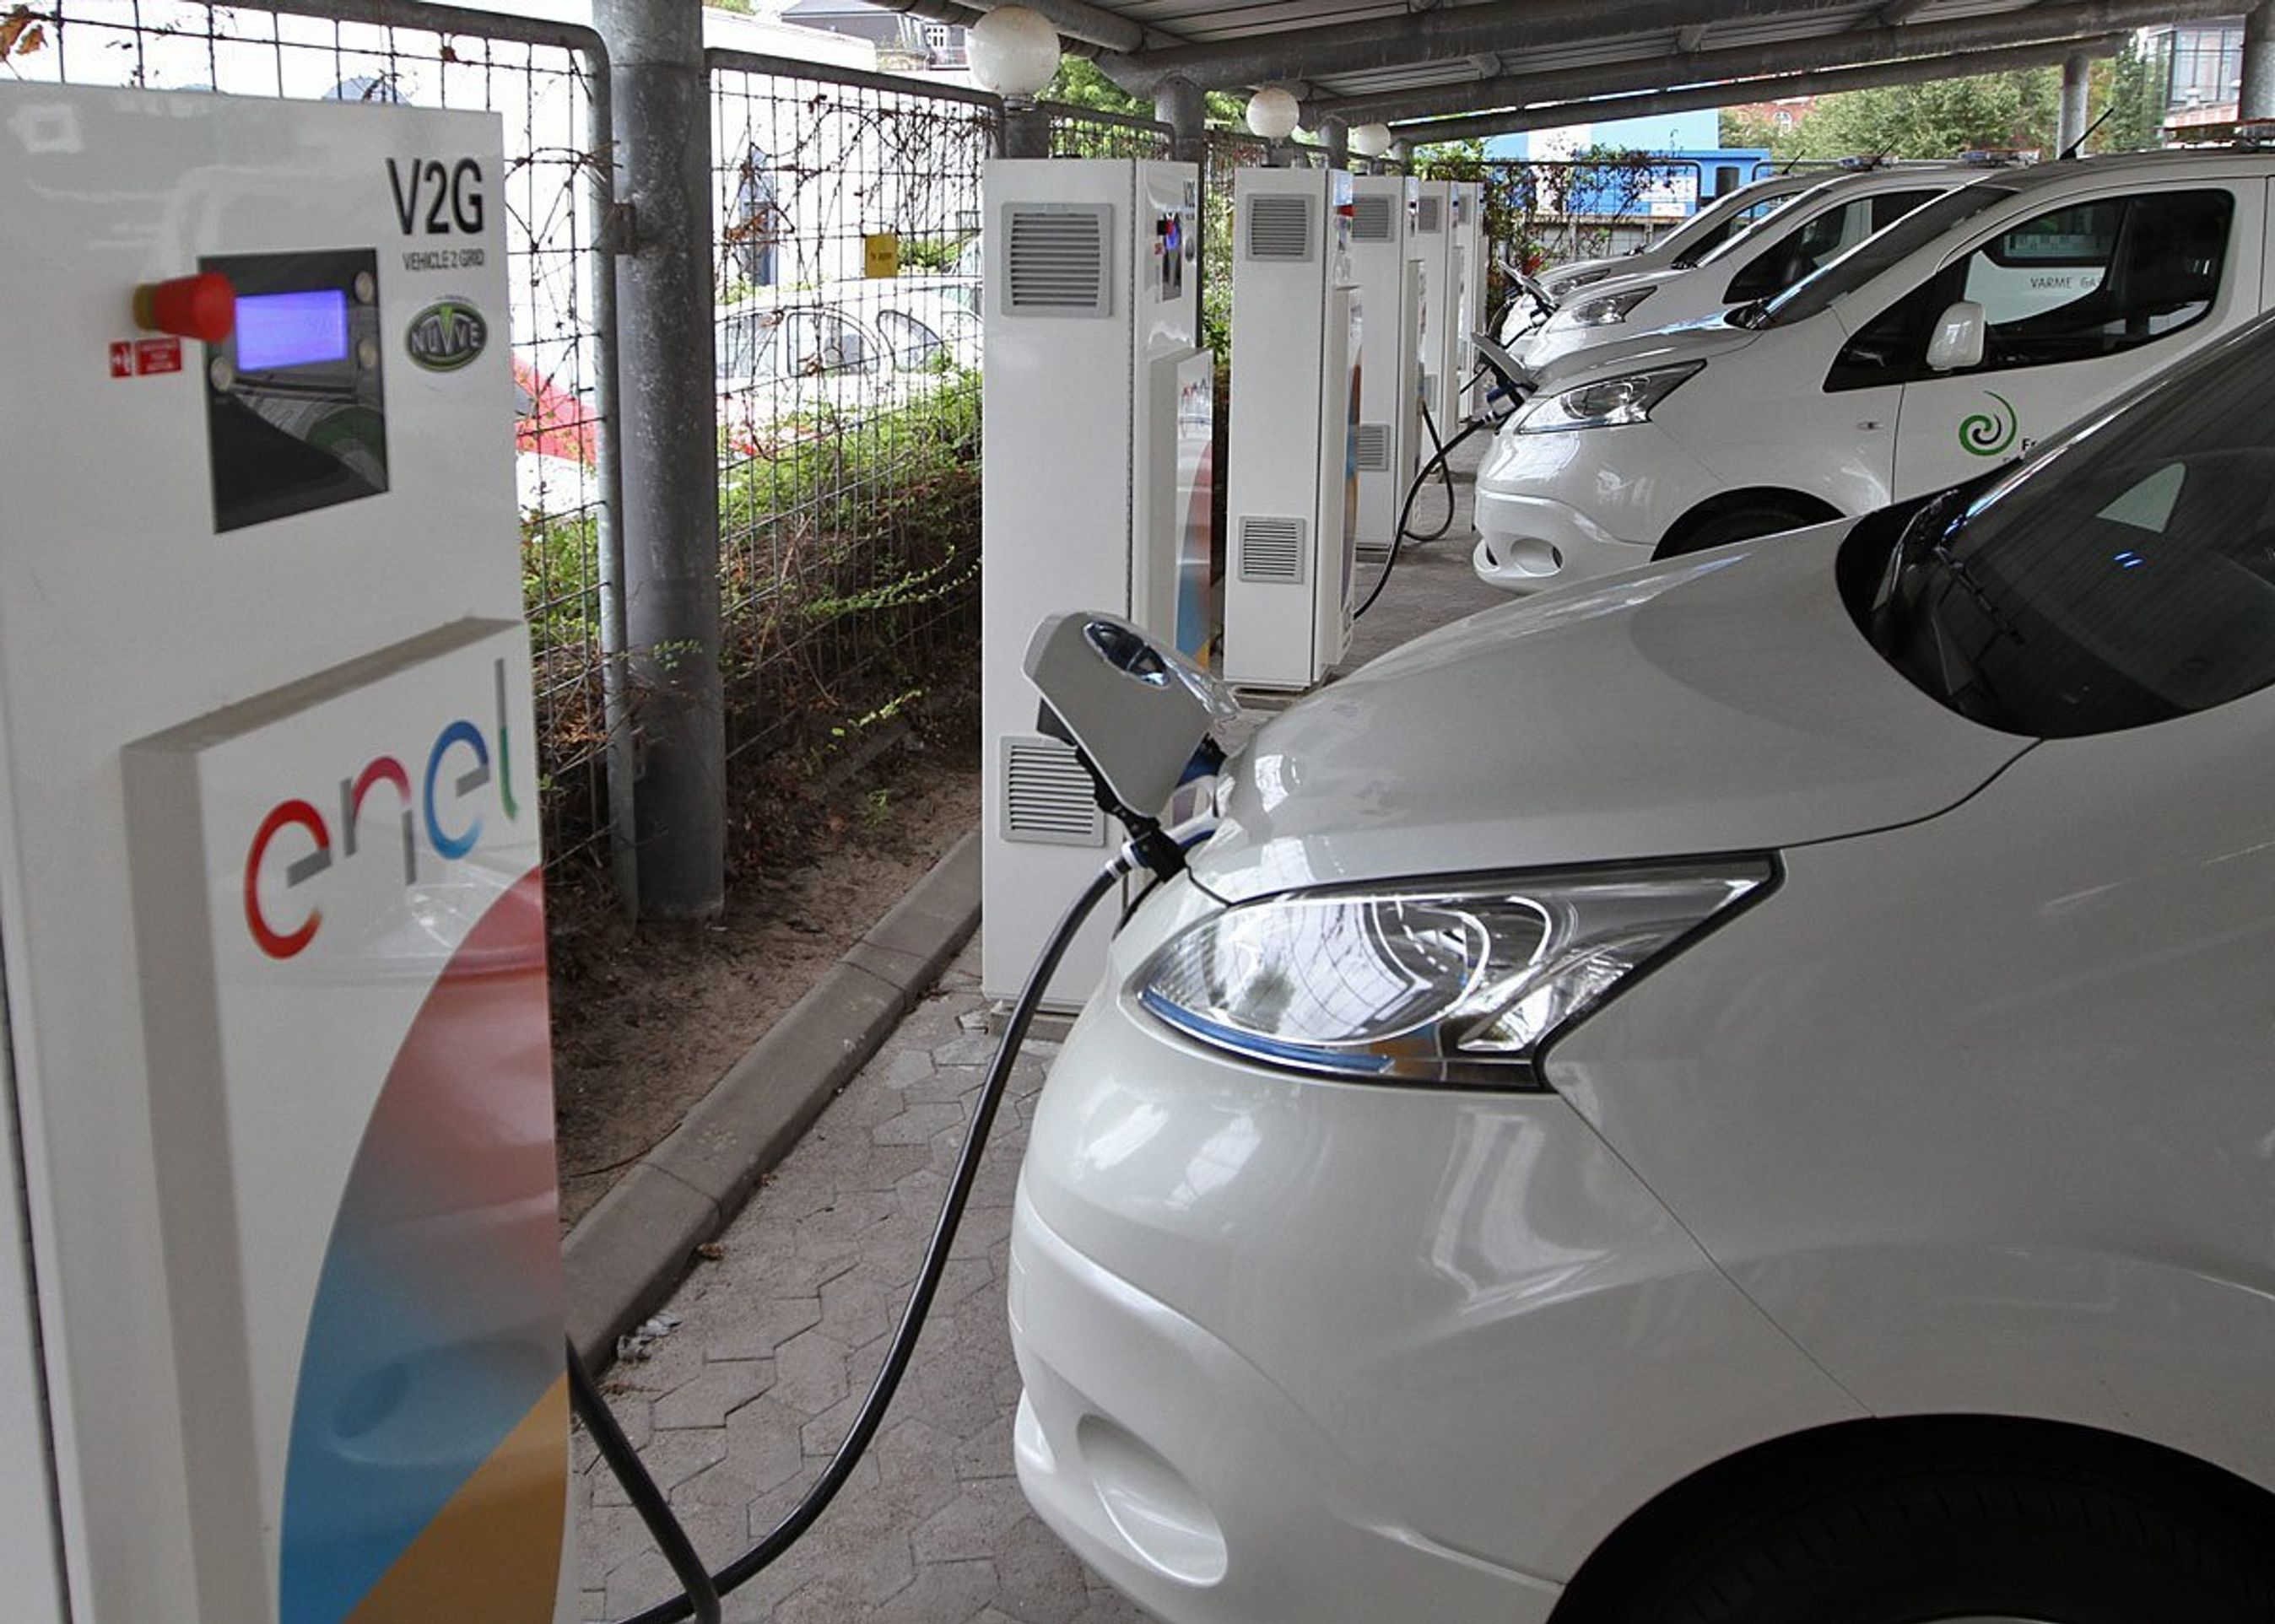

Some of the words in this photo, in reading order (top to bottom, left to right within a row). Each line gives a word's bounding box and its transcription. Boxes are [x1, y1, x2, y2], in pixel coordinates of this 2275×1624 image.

[386, 157, 484, 235] V2G
[402, 251, 448, 271] VEHICLE
[2029, 277, 2072, 289] VARME
[243, 657, 518, 960] enel
